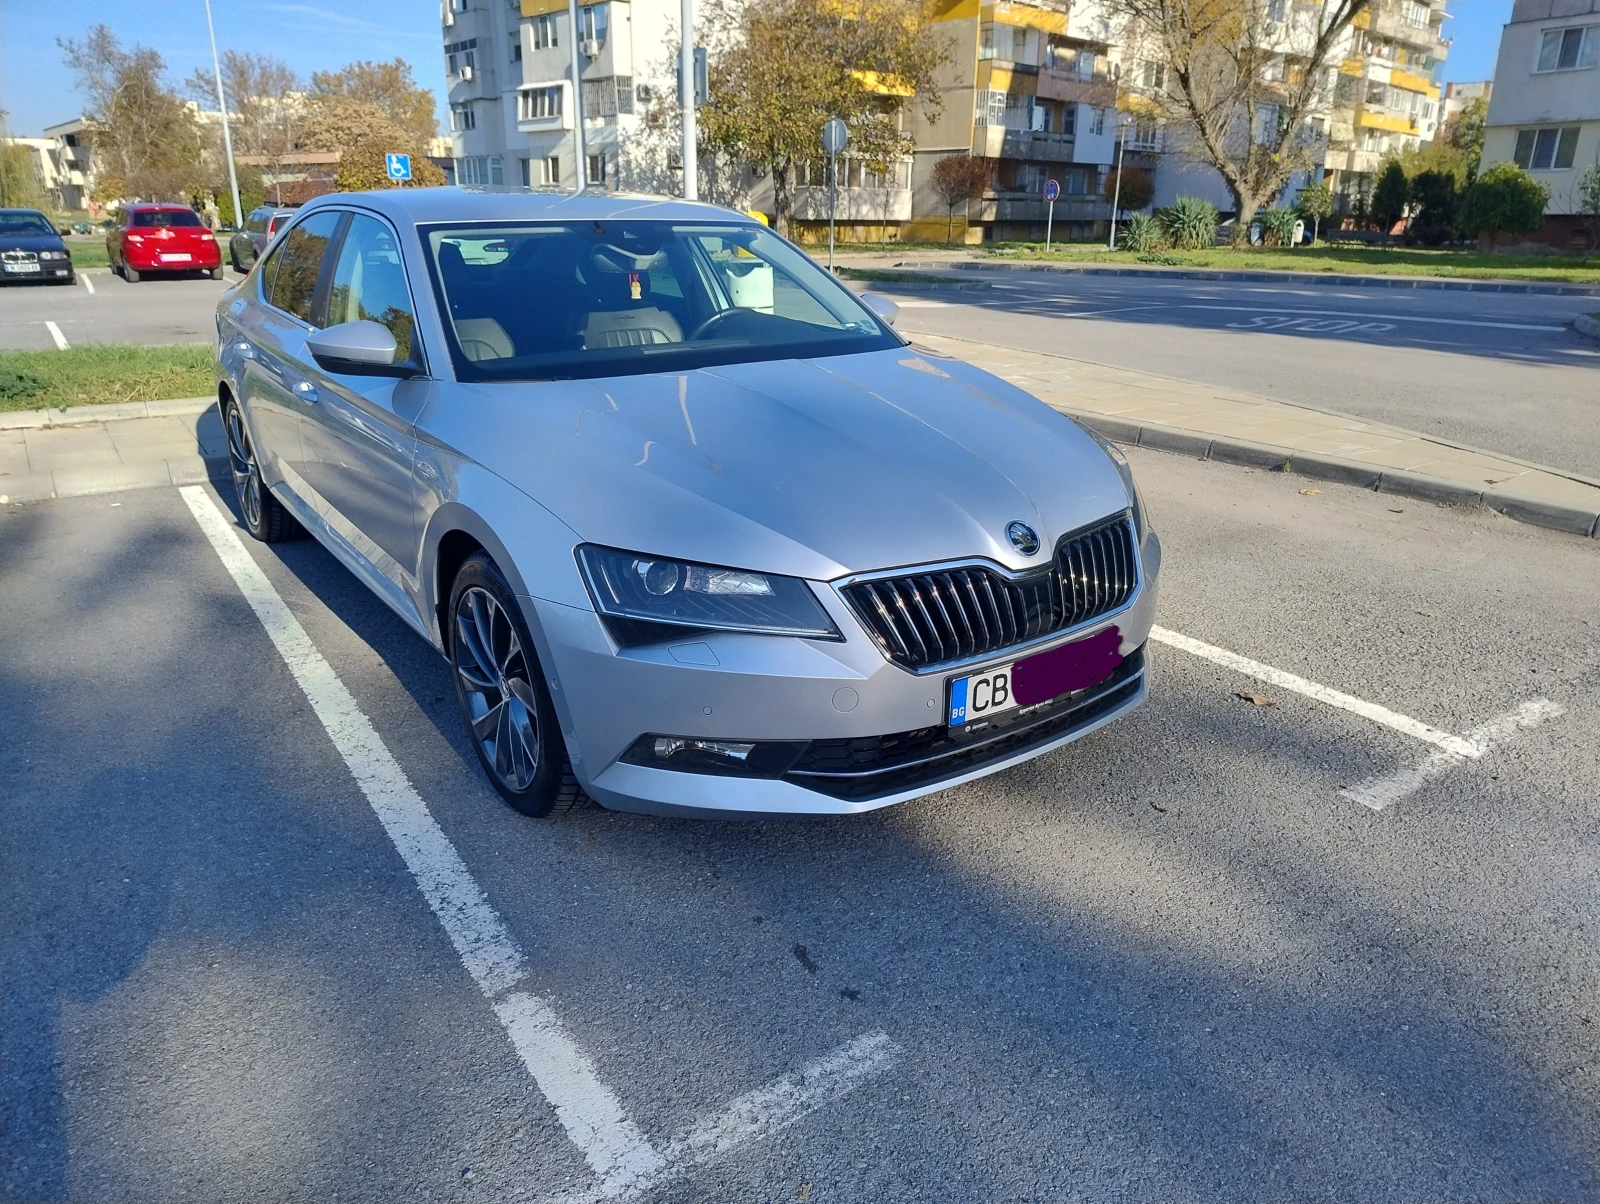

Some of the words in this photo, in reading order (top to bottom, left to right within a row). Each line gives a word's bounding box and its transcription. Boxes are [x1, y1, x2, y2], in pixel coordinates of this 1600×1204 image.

[1225, 316, 1397, 333] STOP
[972, 673, 1009, 712] CB
[952, 706, 965, 719] BG
